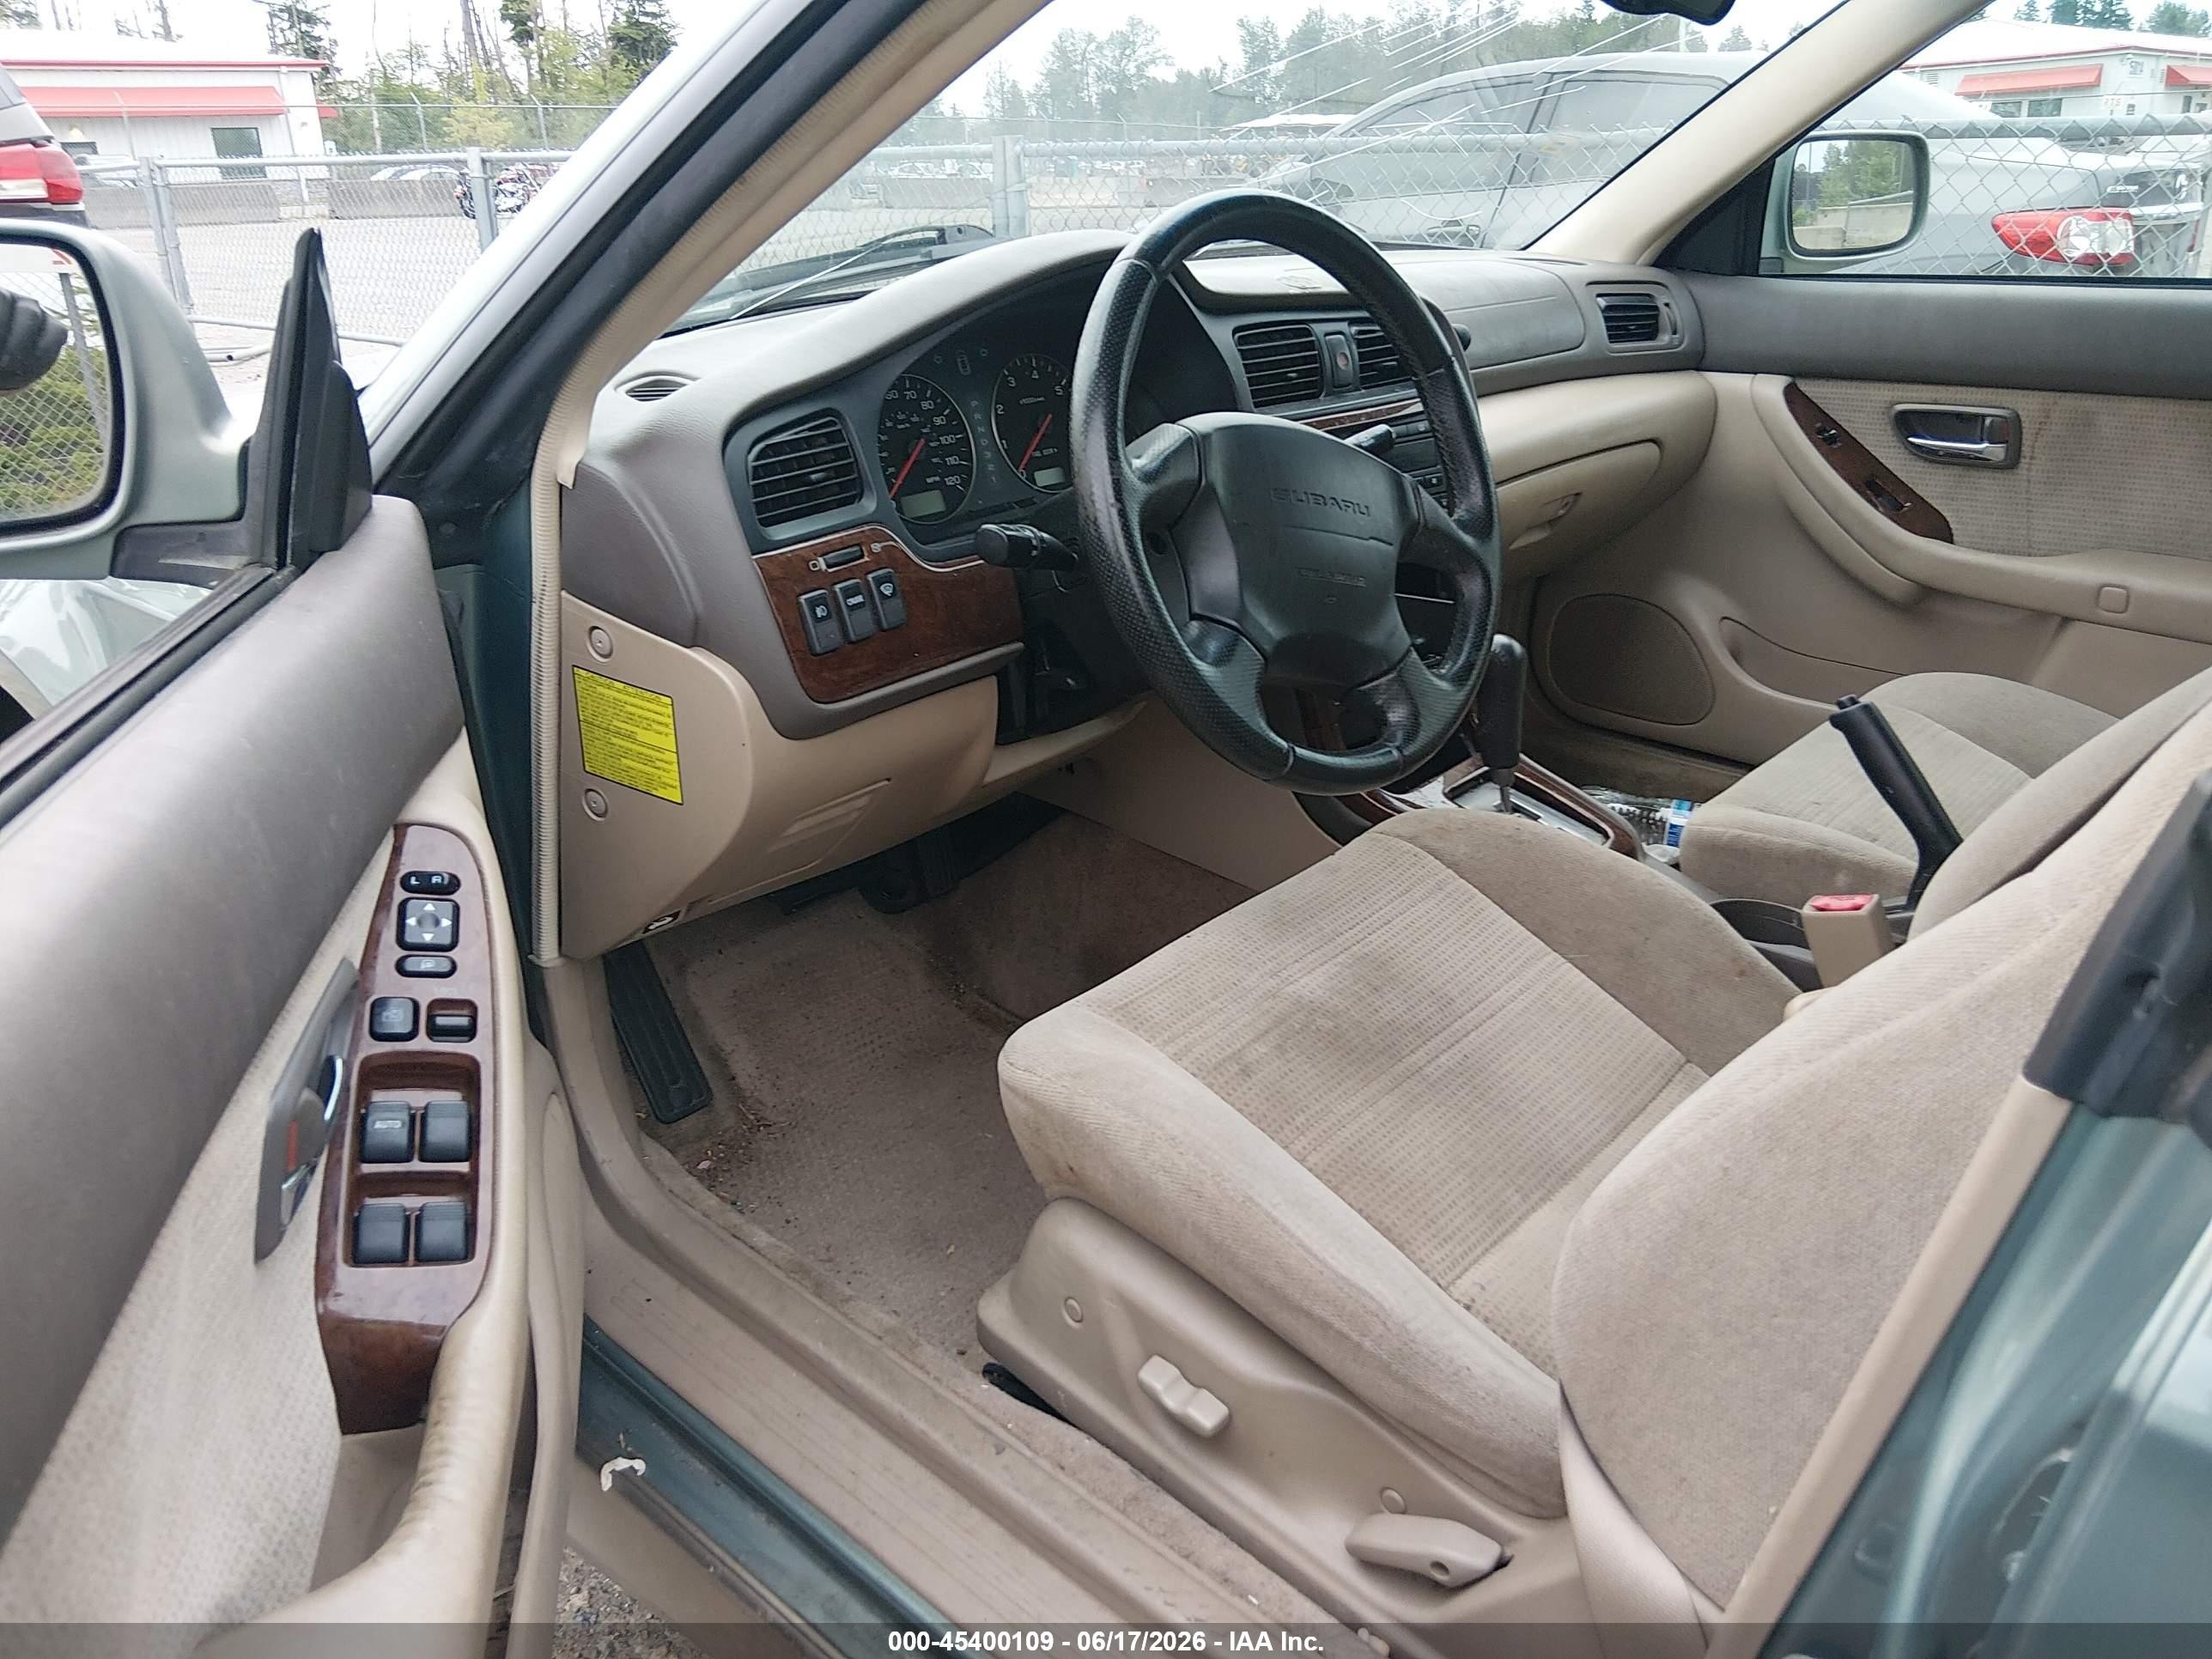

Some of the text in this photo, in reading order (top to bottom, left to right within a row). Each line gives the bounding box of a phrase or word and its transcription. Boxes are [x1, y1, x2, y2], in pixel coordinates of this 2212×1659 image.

[1006, 377, 1016, 387] 3
[903, 390, 917, 400] 70
[1054, 386, 1064, 396] 5
[921, 400, 934, 410] 80
[996, 404, 1006, 415] 2
[933, 416, 946, 426] 90
[939, 434, 956, 444] 100
[1000, 439, 1008, 449] 1
[945, 456, 960, 465] 110
[944, 475, 961, 486] 120
[1270, 487, 1371, 518] SUBARU
[410, 875, 441, 884] L R
[373, 1120, 404, 1129] AUTO
